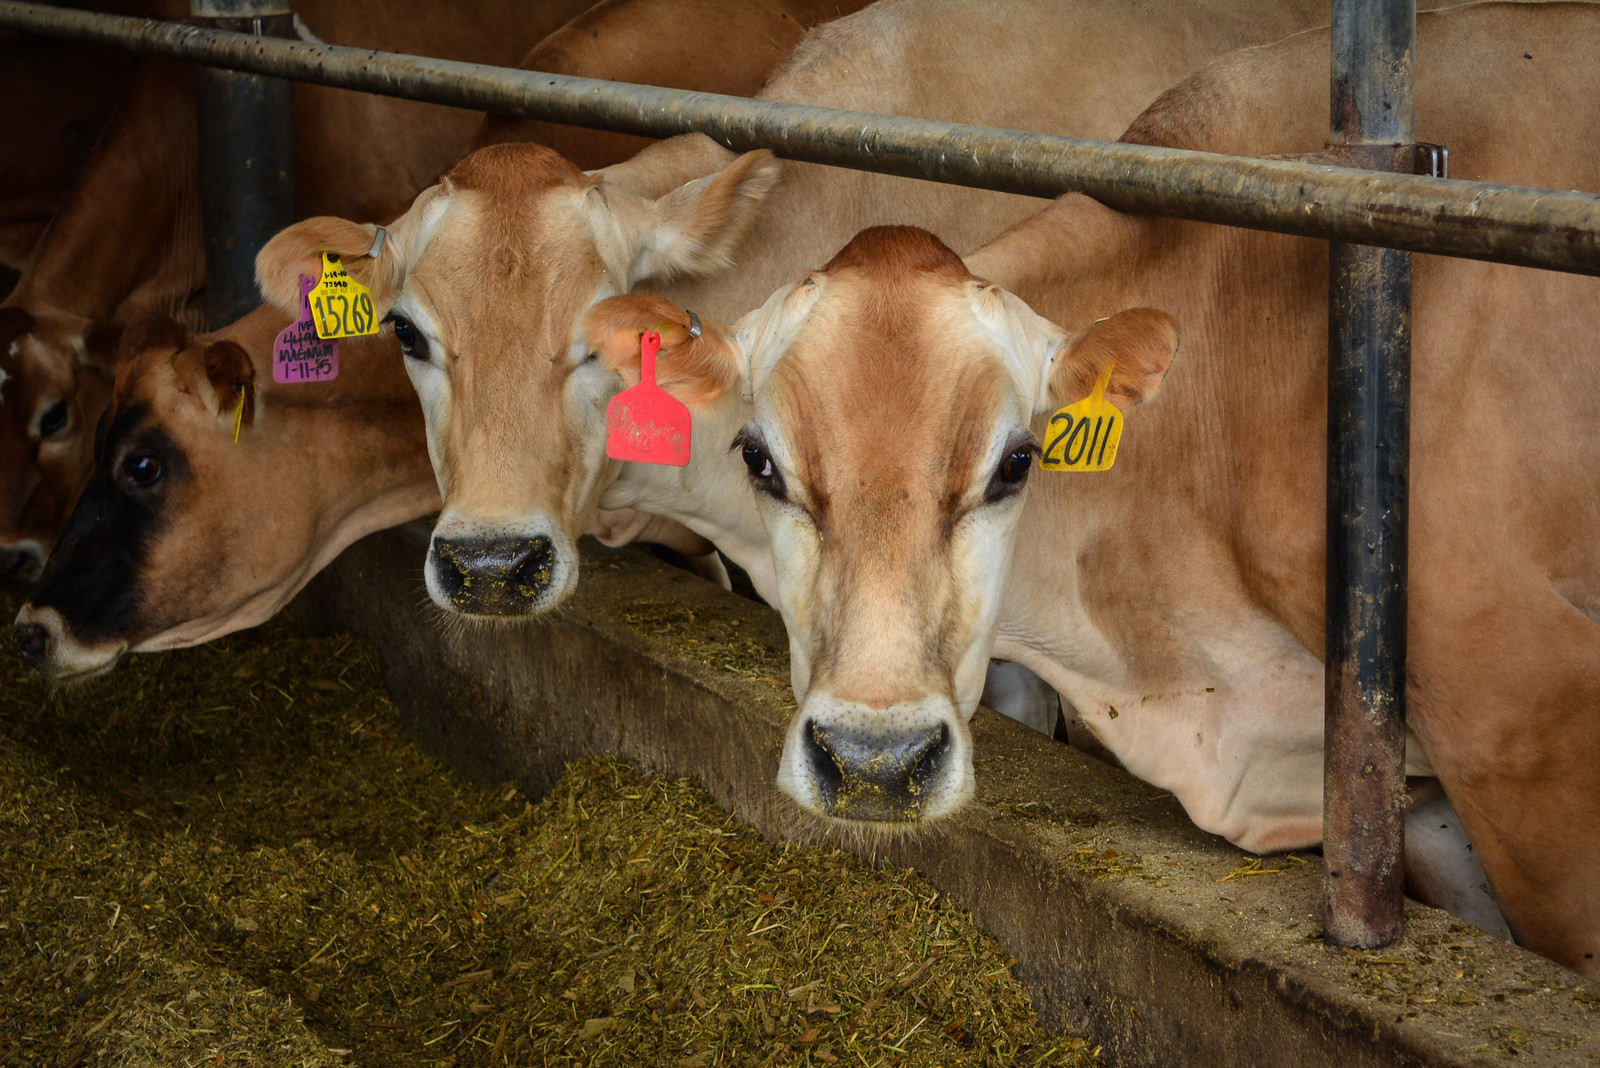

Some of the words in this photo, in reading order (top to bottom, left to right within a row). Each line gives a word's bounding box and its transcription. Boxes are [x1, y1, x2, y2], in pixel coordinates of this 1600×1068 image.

[315, 293, 374, 337] 15269
[279, 344, 333, 363] MAGNUM
[1043, 412, 1115, 466] 2011
